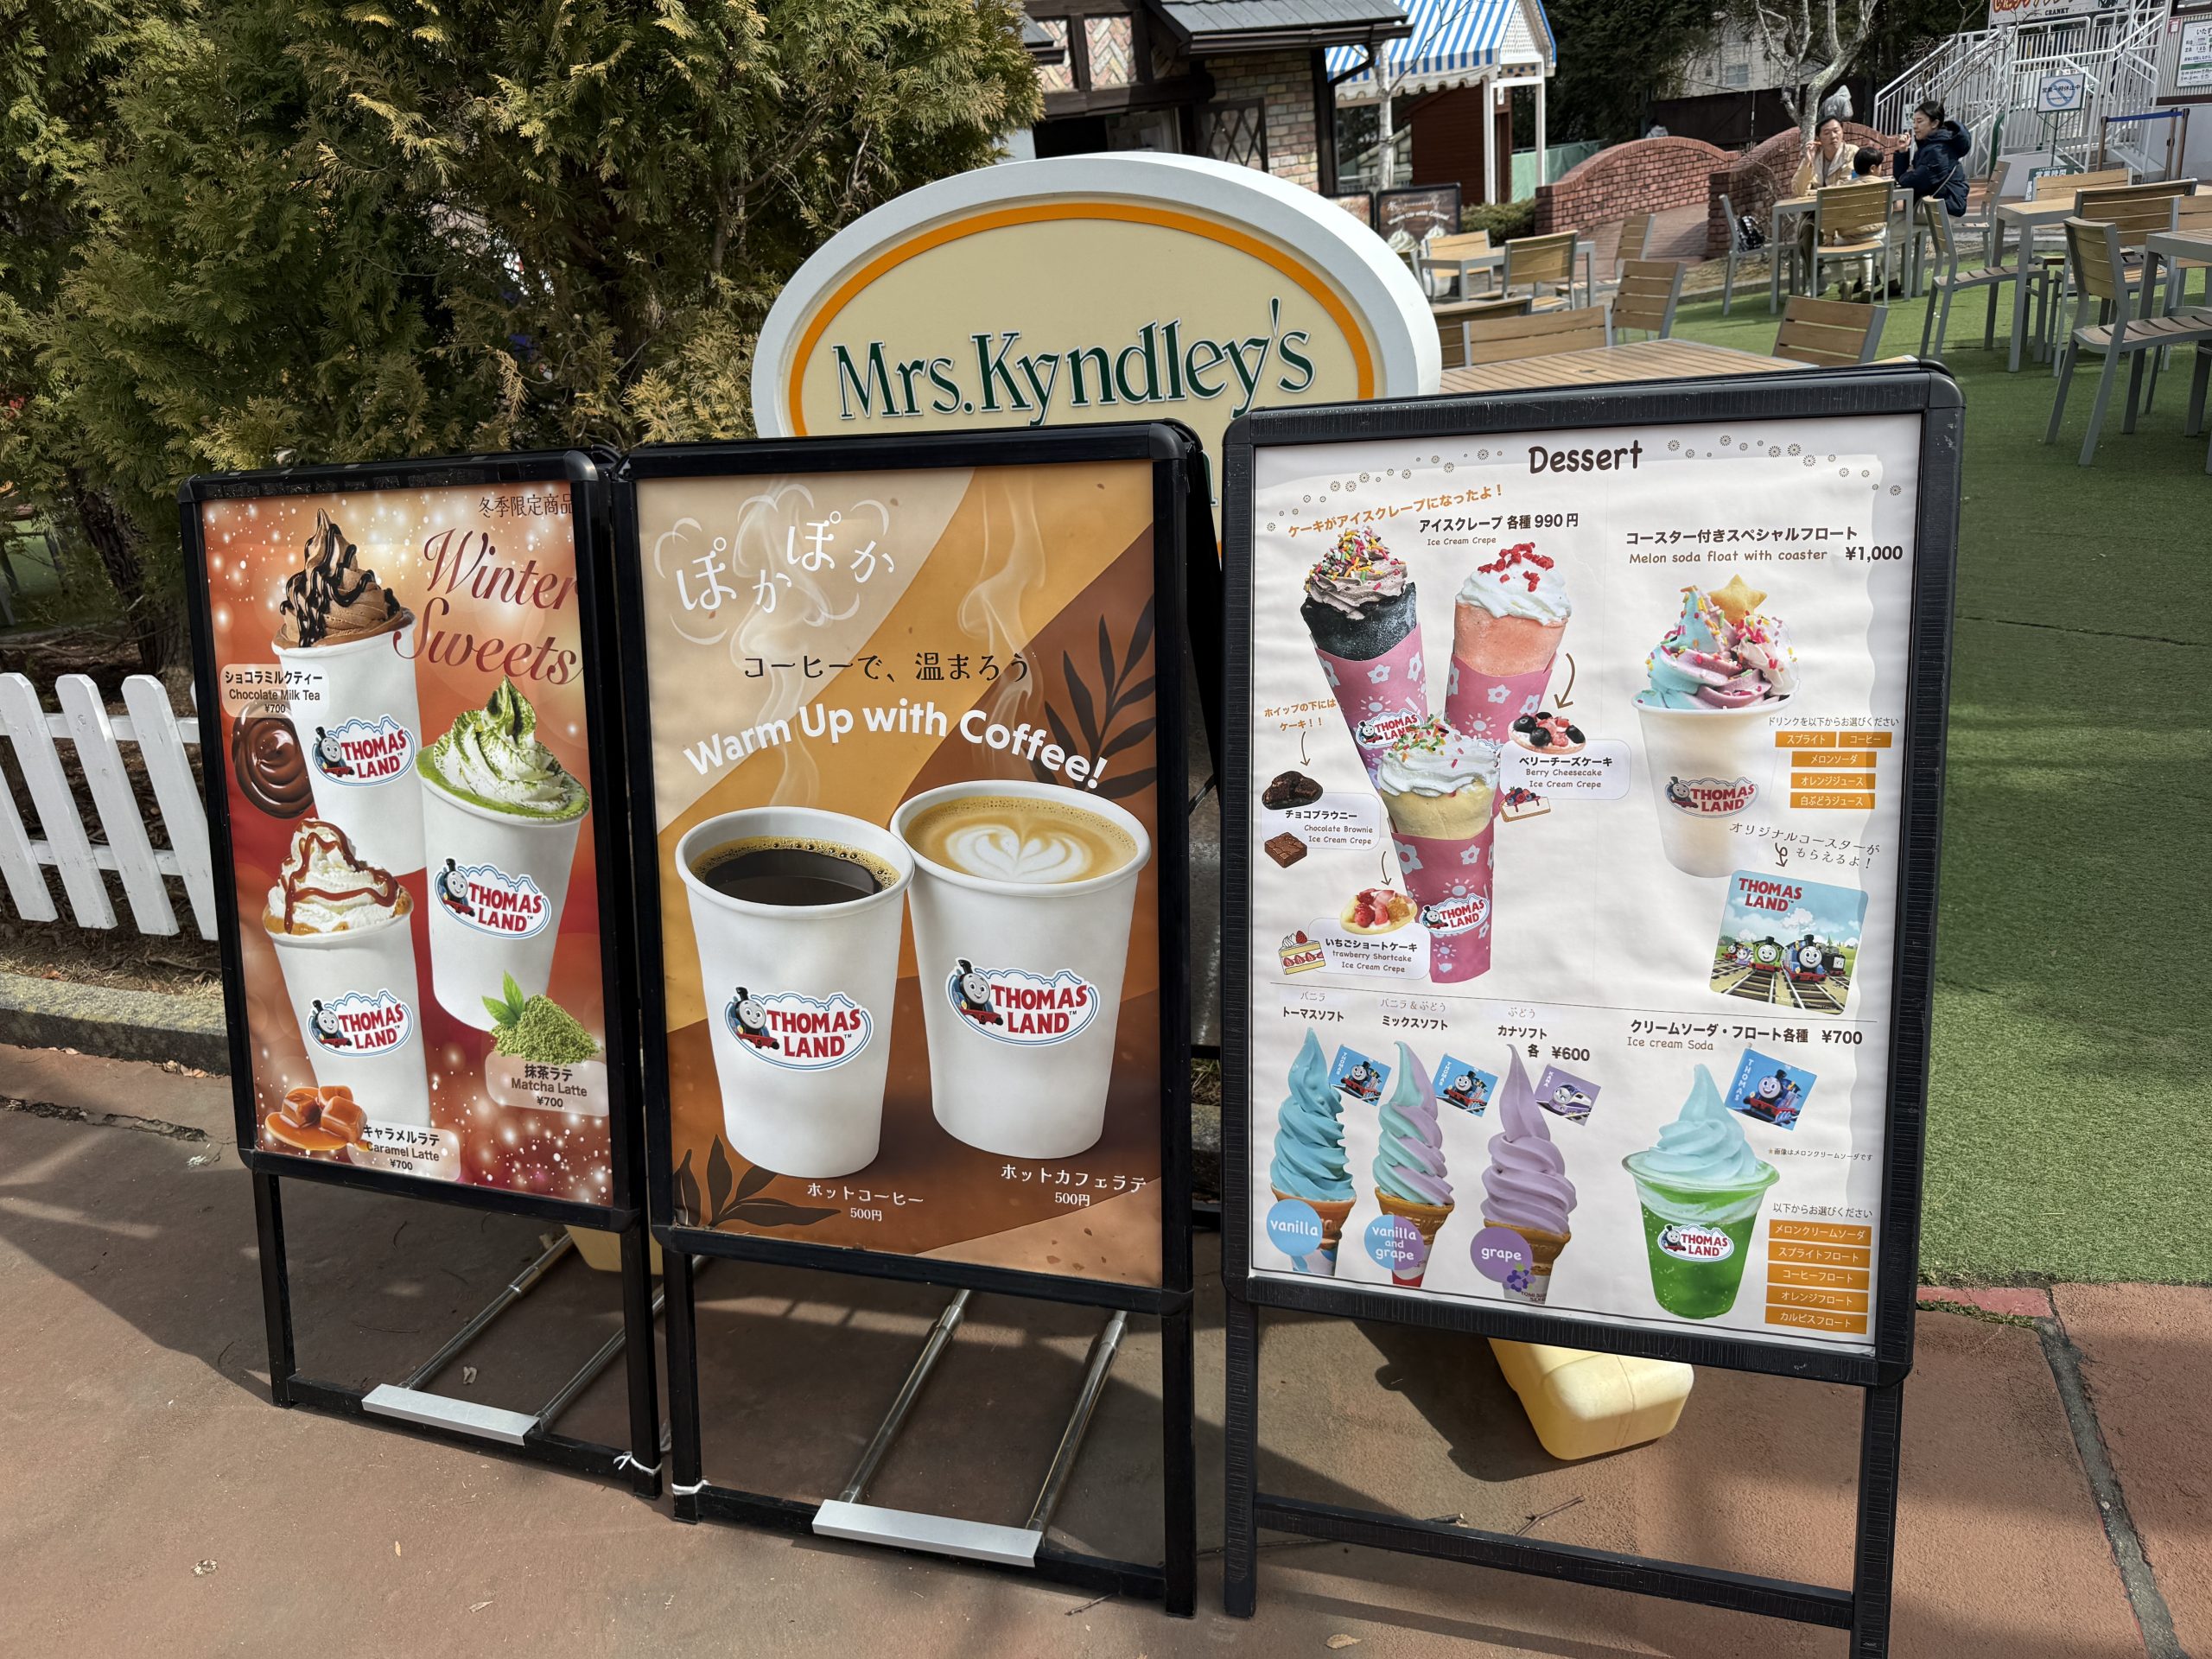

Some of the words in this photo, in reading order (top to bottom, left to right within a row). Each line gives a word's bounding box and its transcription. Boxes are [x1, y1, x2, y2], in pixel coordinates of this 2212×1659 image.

[2044, 7, 2069, 16] CRANKY
[1528, 439, 1643, 474] Dessert
[478, 493, 574, 518] 冬季限定商品
[1287, 484, 1503, 538] ケーキがアイスクレープになったよ！
[1419, 515, 1503, 533] アイスクレープ
[1506, 514, 1531, 531] 各種
[1534, 513, 1563, 529] 990
[1566, 512, 1579, 527] 円
[1427, 537, 1440, 546] Ice
[1443, 537, 1469, 546] Cream
[1471, 536, 1497, 546] Crepe
[1626, 525, 1858, 546] コースター付きスペシャルフロート
[1629, 552, 1667, 564] Melon
[1671, 551, 1701, 563] soda
[1707, 550, 1738, 563] float
[1744, 550, 1772, 562] with
[1777, 549, 1827, 561] coaster
[1845, 545, 1904, 563] ¥1,000
[423, 526, 579, 610] Winter
[392, 595, 584, 686] Sweets
[744, 652, 1030, 683] コーヒーで、温まろう
[225, 670, 323, 686] ショコラミルクティー
[229, 688, 278, 702] Chocolate
[280, 688, 301, 701] Milk
[302, 688, 321, 701] Tea
[264, 703, 286, 715] ¥700
[1264, 698, 1338, 718] ホイップの下には
[1374, 714, 1418, 734] THOMAS
[1768, 716, 1900, 728] ドリンクを以下からお選びください
[340, 728, 406, 764] THOMAS
[683, 715, 791, 776] Warm
[798, 702, 855, 746] Up
[866, 697, 949, 738] with
[959, 709, 1108, 790] Coffee!
[1787, 734, 1826, 745] スプライト
[1849, 734, 1882, 745] コーヒー
[357, 754, 400, 779] LAND
[1519, 755, 1613, 767] ベリーチーズケーキ
[1810, 753, 1858, 766] メロンソーダ
[1525, 768, 1549, 778] Berry
[1552, 767, 1602, 777] Cheesecake
[1546, 779, 1572, 788] Cream
[1574, 779, 1602, 791] Crepe
[1800, 776, 1864, 787] オレンジジュース
[1689, 782, 1755, 801] THOMAS
[1700, 798, 1745, 813] LAND
[1800, 796, 1863, 807] 白ぶどうジュース
[1284, 809, 1357, 822] チョコブラウニー
[1304, 823, 1341, 834] Chocolate
[1343, 825, 1373, 835] Brownie
[1308, 834, 1322, 843] Ice
[1324, 836, 1348, 845] Cream
[1350, 836, 1372, 847] Crepe
[1729, 822, 1880, 854] オリジナルコースターが
[1796, 847, 1872, 869] もらえるよ！
[1738, 877, 1802, 900] THOMAS
[468, 881, 543, 915] THOMAS
[1744, 893, 1789, 912] LAND
[1440, 898, 1485, 920] THOMAS
[477, 910, 528, 932] LAND
[1448, 911, 1480, 927] LAND
[1325, 938, 1418, 952] いちごショートケーキ
[1332, 950, 1370, 961] trawberry
[1373, 953, 1412, 963] Shortcake
[1357, 963, 1381, 971] Cream
[1382, 964, 1406, 974] Crepe
[990, 982, 1088, 1009] THOMAS
[1300, 991, 1326, 1002] バニラ
[338, 1002, 404, 1033] THOMAS
[766, 1007, 862, 1035] THOMAS
[1282, 1007, 1344, 1023] トーマスソフト
[1507, 1006, 1536, 1019] ぶどう
[1006, 1008, 1070, 1035] LAND
[1382, 1014, 1449, 1031] ミックスソフト
[353, 1027, 397, 1051] LAND
[1497, 1025, 1548, 1040] カナソフト
[1630, 1020, 1809, 1044] クリームソーダ・フロート各種
[1821, 1029, 1863, 1046] ¥700
[783, 1033, 845, 1058] LAND
[1627, 1036, 1644, 1047] Ice
[1649, 1039, 1683, 1049] cream
[1687, 1039, 1714, 1052] Soda
[1528, 1044, 1540, 1058] 各
[1551, 1046, 1591, 1062] ¥600
[524, 1063, 574, 1082] 抹茶ラテ
[1335, 1052, 1348, 1076] THOMAS
[1438, 1061, 1452, 1086] THOMAS
[1541, 1070, 1554, 1089] KANA
[1733, 1058, 1755, 1102] THOMAS
[511, 1077, 555, 1094] Matcha
[557, 1081, 588, 1098] Latte
[536, 1096, 564, 1109] ¥700
[363, 1124, 441, 1147] キャラメルラテ
[366, 1141, 409, 1158] Caramel
[411, 1147, 440, 1162] Latte
[390, 1159, 413, 1171] ¥700
[1000, 1163, 1147, 1194] ホットカフェラテ
[806, 1181, 925, 1207] ホットコーヒー
[1054, 1192, 1091, 1207] 500円
[849, 1207, 883, 1223] 500円
[1772, 1202, 1873, 1220] 以下からお選びください
[1270, 1219, 1319, 1236] vanilla
[1371, 1225, 1417, 1241] vanilla
[1774, 1224, 1866, 1241] メロンクリームソーダ
[1384, 1240, 1404, 1249] and
[1681, 1232, 1729, 1248] THOMAS
[1375, 1248, 1414, 1262] grape
[1480, 1246, 1522, 1262] grape
[1688, 1244, 1720, 1257] LAND
[1777, 1246, 1859, 1264] スプライトフロート
[1782, 1268, 1853, 1284] コーヒーフロート
[1780, 1290, 1853, 1307] オレンジフロート
[1779, 1310, 1852, 1329] カルピスフロート
